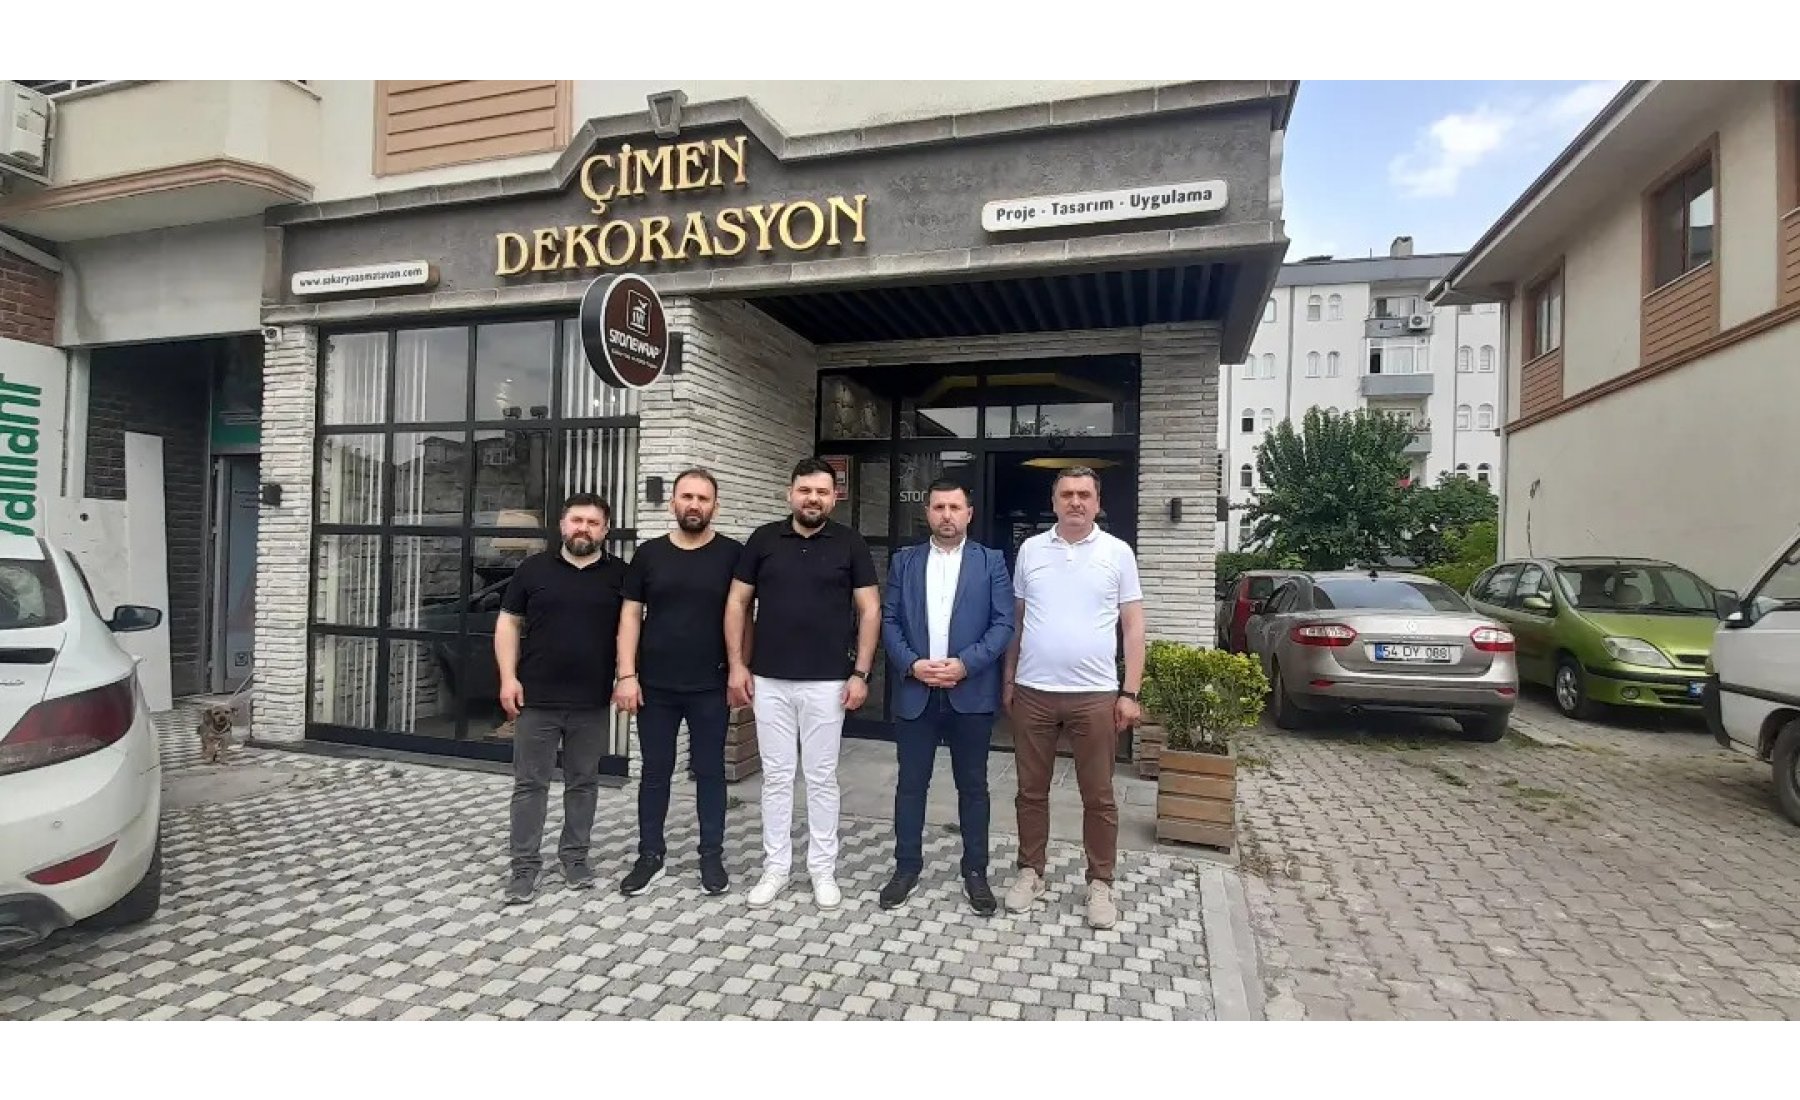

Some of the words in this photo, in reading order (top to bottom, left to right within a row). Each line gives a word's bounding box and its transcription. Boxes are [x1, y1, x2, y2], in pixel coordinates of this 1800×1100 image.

[579, 135, 748, 215] ÇİMEN
[996, 207, 1035, 222] Proje
[1051, 199, 1114, 216] Tasarım
[1130, 189, 1212, 210] Uygulama
[495, 194, 868, 276] DEKORASYON
[1383, 645, 1397, 656] 54
[1403, 646, 1419, 656] DY
